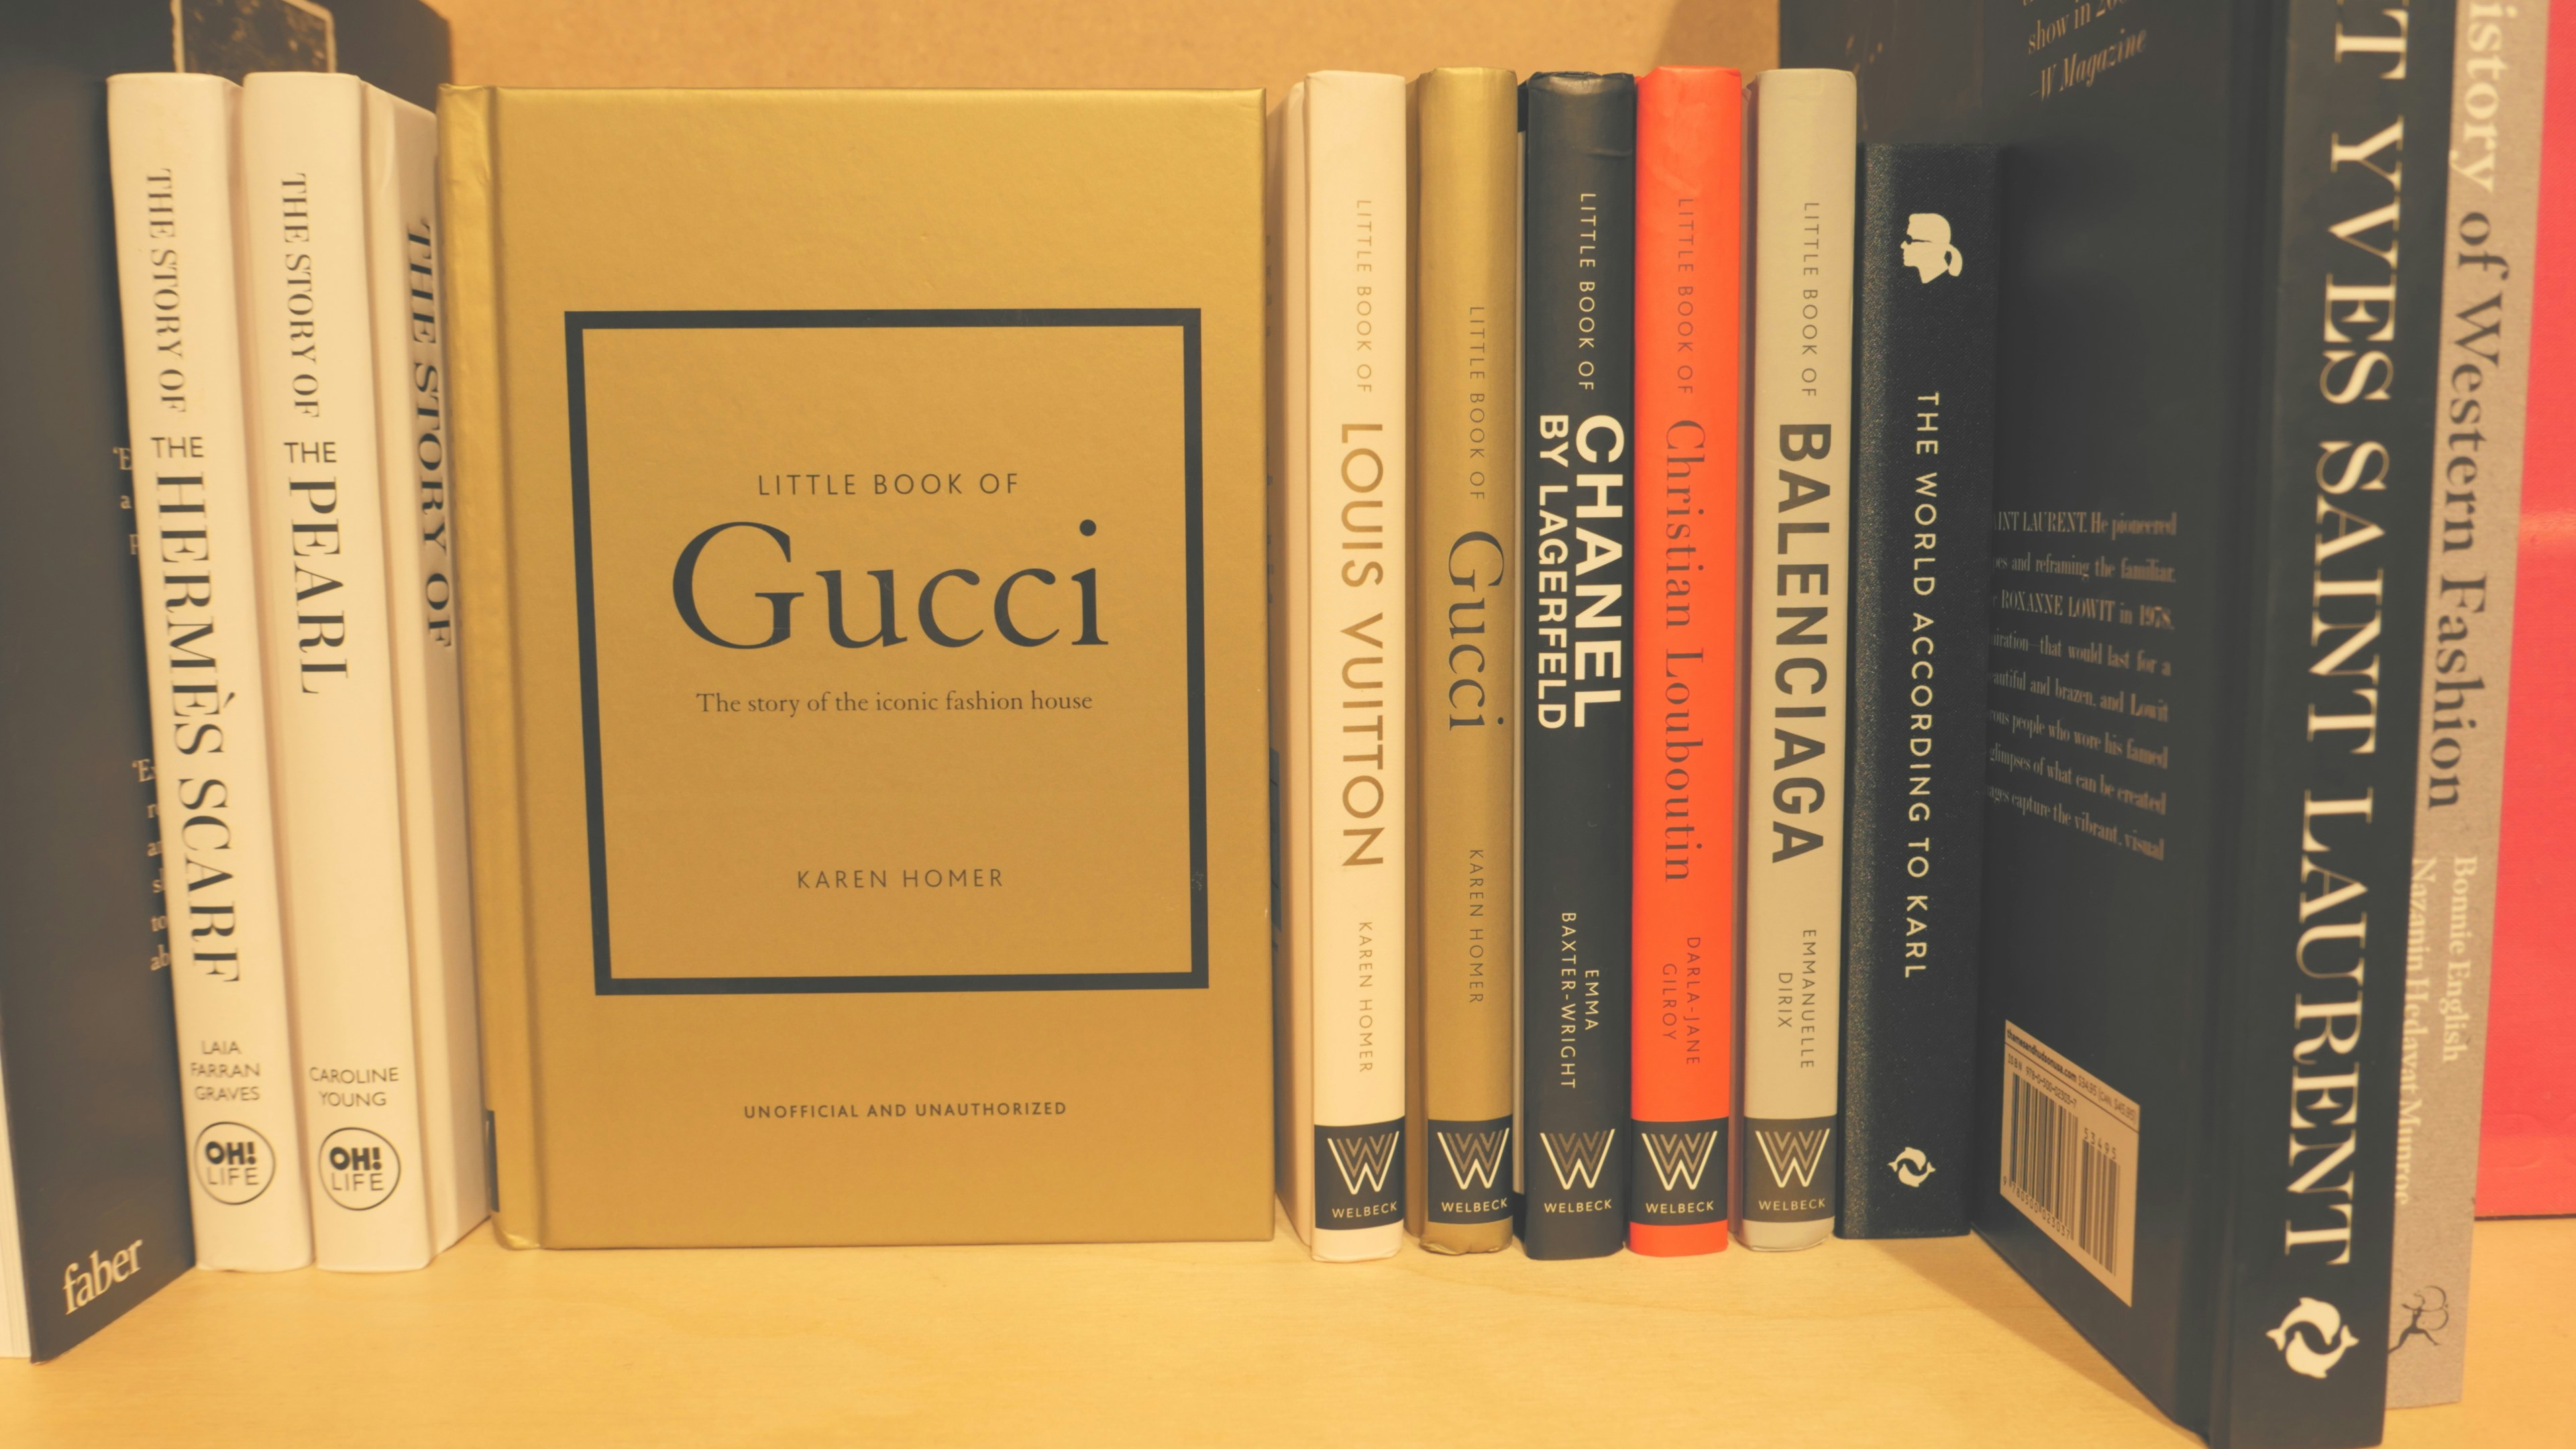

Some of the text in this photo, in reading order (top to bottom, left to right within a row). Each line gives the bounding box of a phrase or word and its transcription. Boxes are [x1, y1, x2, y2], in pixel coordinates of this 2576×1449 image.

[2028, 13, 2069, 55] show
[2074, 0, 2090, 30] in
[2059, 28, 2146, 93] Magazine
[2320, 114, 2404, 404] YVES
[2458, 212, 2510, 282] of
[146, 168, 186, 413] THE STORY OF
[281, 172, 320, 417] THE STORY OF
[1356, 200, 1372, 392] LITTLE BOOK OF
[1578, 193, 1596, 390] LITTLE BOOK OF
[1677, 199, 1694, 394] LITTLE BOOK OF
[1801, 203, 1819, 396] LITTLE BOOK OF
[407, 218, 452, 648] THE STORY OF
[1469, 307, 1485, 499] LITTLE BOOK OF
[2443, 292, 2503, 554] Western
[150, 437, 205, 458] THE
[284, 441, 337, 464] THE
[759, 473, 1018, 495] LITTLE BOOK OF
[2023, 512, 2088, 533] LAURENT.
[2091, 513, 2108, 534] He
[2112, 511, 2177, 541] pioneered
[288, 476, 348, 694] PEARL
[672, 519, 1109, 650] Gucci
[1538, 415, 1568, 729] BY LAGERFELD
[1574, 415, 1625, 728] CHANEL
[2012, 551, 2031, 572] and
[2036, 553, 2090, 582] reframing
[2094, 556, 2115, 579] the
[2308, 441, 2390, 754] SAINT
[1448, 531, 1504, 731] Gucci
[2001, 590, 2063, 616] ROXANNE
[2068, 596, 2115, 623] LOWIT
[2120, 601, 2133, 625] in
[1340, 423, 1385, 866] LOUIS VUITTON
[1664, 420, 1706, 883] Christian Louboutin
[1772, 424, 1832, 864] BALENCIAGA
[2068, 641, 2102, 665] would
[2108, 645, 2130, 669] last
[2137, 650, 2158, 674] for
[2161, 660, 2171, 676] a
[696, 690, 1093, 718] The story of the iconic fashion house
[1904, 392, 1939, 977] THE WORLD ACCORDING TO KARL
[2030, 677, 2050, 697] and
[2100, 690, 2124, 713] and
[2131, 694, 2169, 723] Lowit
[2428, 573, 2487, 810] Fashion
[156, 471, 239, 982] HERMÈS SCARF
[2012, 714, 2045, 738] people
[2048, 718, 2070, 742] who
[2074, 729, 2101, 753] wore
[2104, 733, 2123, 755] his
[2127, 738, 2168, 769] famed
[1990, 742, 2166, 816] glimpses of what can be created
[2012, 793, 2051, 817] capture
[2053, 803, 2072, 826] the
[2124, 829, 2164, 861] visual
[798, 869, 1003, 889] KAREN HOMER
[2407, 857, 2436, 973] Nazanin
[1469, 849, 1484, 1004] KAREN HOMER
[2438, 856, 2478, 1065] Bonnie English
[1358, 922, 1373, 1073] KAREN HOMER
[1561, 913, 1577, 1088] BAXTER-WRIGHT
[1585, 970, 1599, 1030] EMMA
[1662, 963, 1677, 1040] GILROY
[1684, 936, 1701, 1065] DARLA-JANE
[1778, 973, 1792, 1028] DIRIX
[1801, 930, 1817, 1069] EMMANUELLE
[2285, 788, 2373, 1265] LAURENT
[191, 1062, 260, 1079] FARRAN
[202, 1040, 241, 1056] LAIA
[309, 1067, 399, 1084] CAROLINE
[2008, 1053, 2022, 1071] ISBN
[194, 1085, 260, 1102] GRAVES
[319, 1091, 387, 1107] YOUNG
[744, 1102, 1067, 1119] UNOFFICIAL AND UNAUTHORIZED
[205, 1141, 256, 1165] OH!
[206, 1167, 260, 1186] LIFE
[329, 1146, 382, 1171] OH!
[2082, 1127, 2117, 1160] 53495
[2394, 1099, 2422, 1205] Munroe
[330, 1173, 384, 1191] LIFE
[1332, 1201, 1398, 1219] WELBECK
[1441, 1198, 1508, 1214] WELBECK
[1544, 1199, 1612, 1214] WELBECK
[1646, 1201, 1715, 1214] WELBECK
[1758, 1197, 1825, 1212] WELBECK
[62, 1239, 143, 1315] faber
